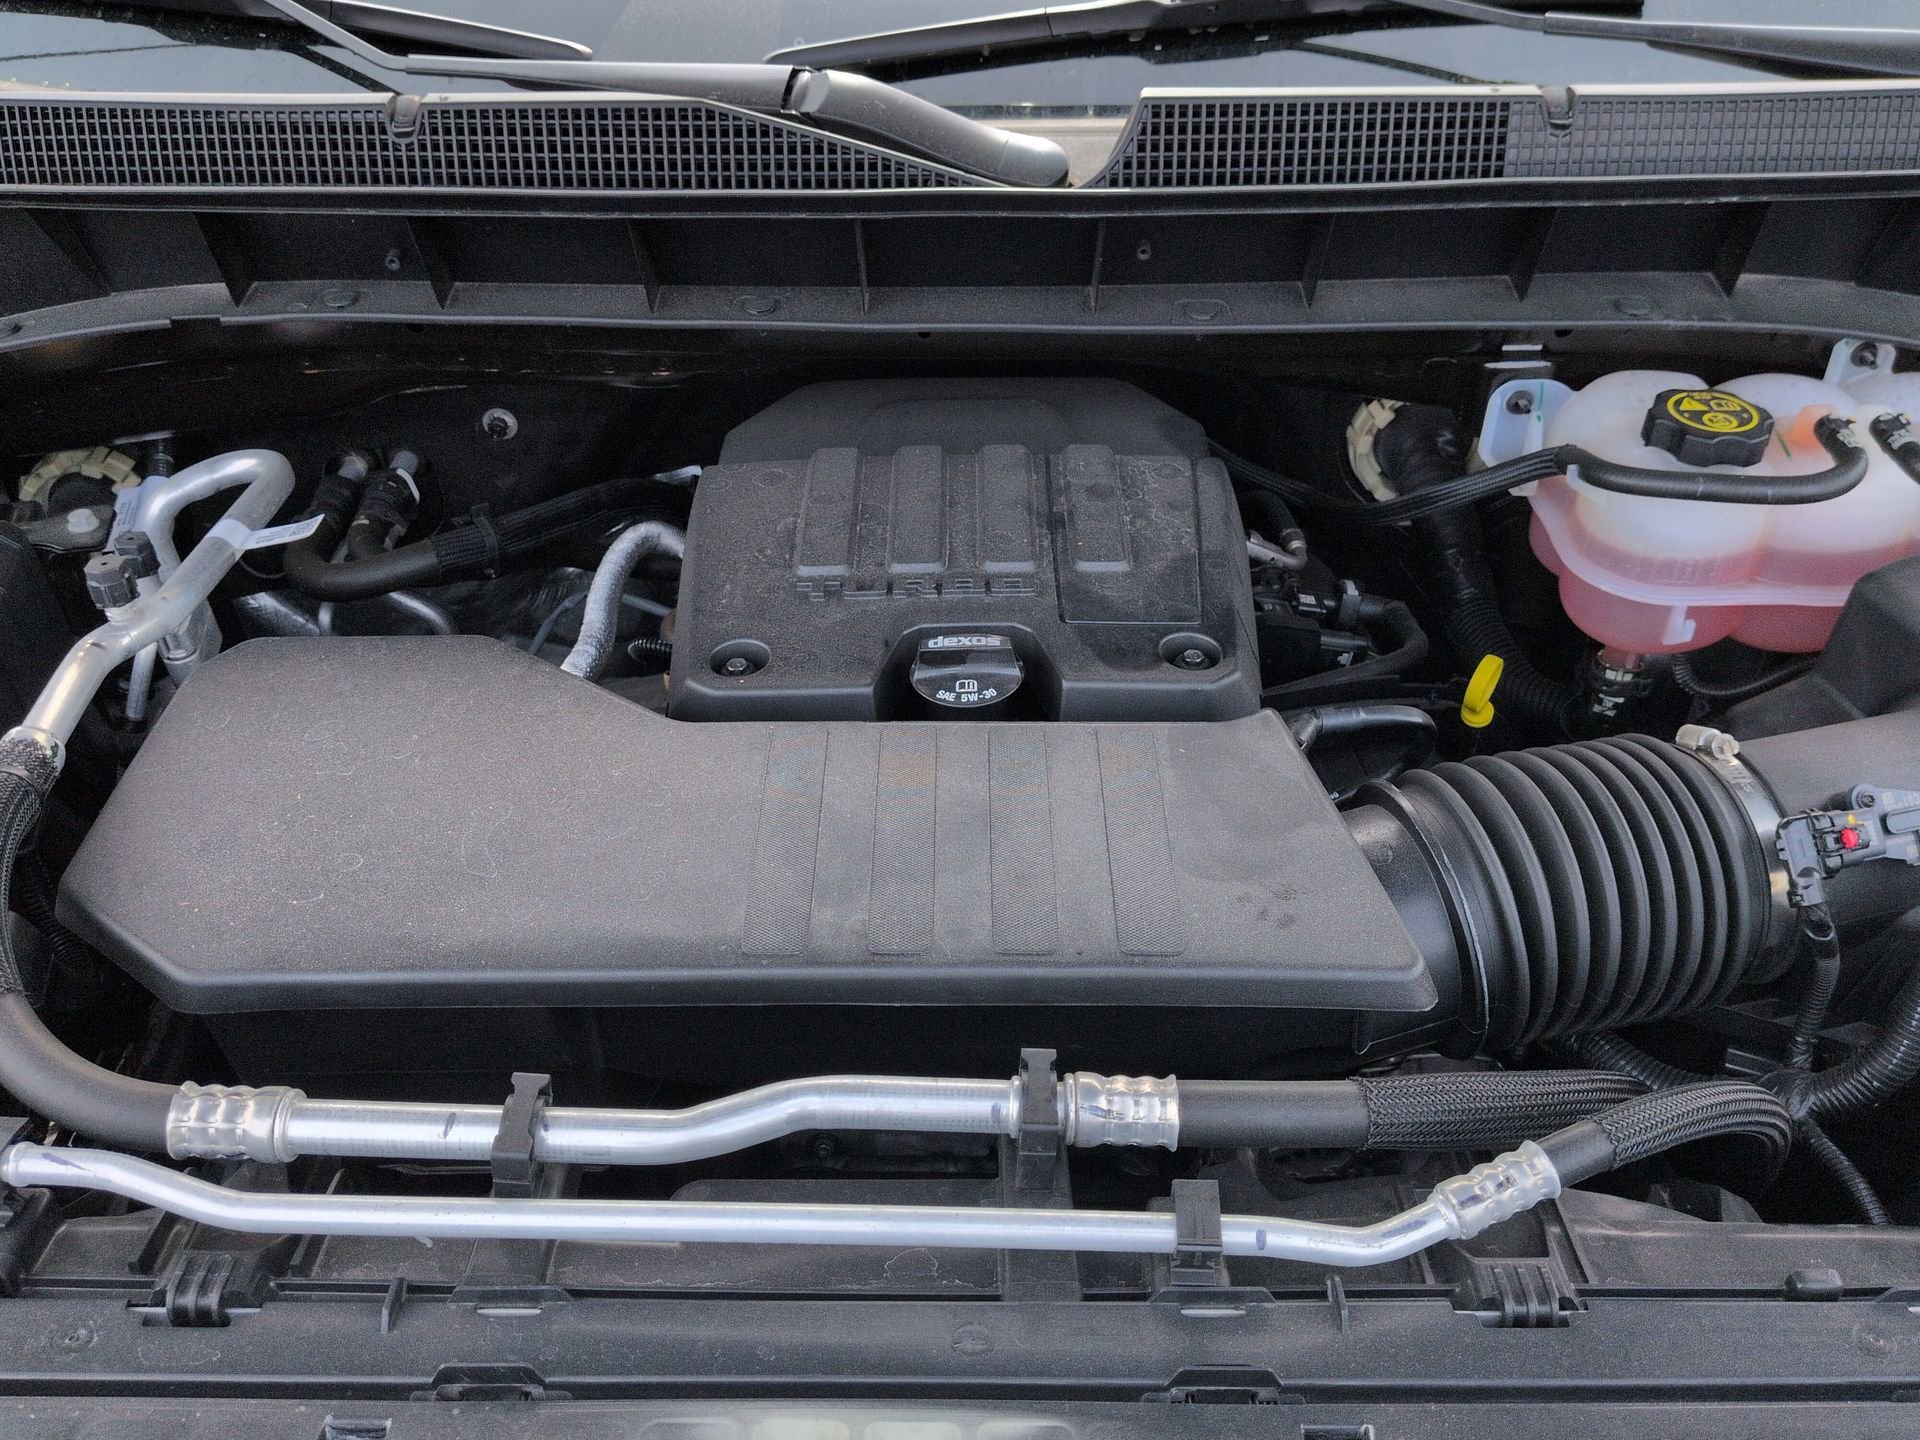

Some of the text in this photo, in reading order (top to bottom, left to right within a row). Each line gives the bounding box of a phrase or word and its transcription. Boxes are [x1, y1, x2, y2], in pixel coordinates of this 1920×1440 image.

[927, 635, 1002, 648] dexos
[935, 688, 998, 702] SAE 5W-30
